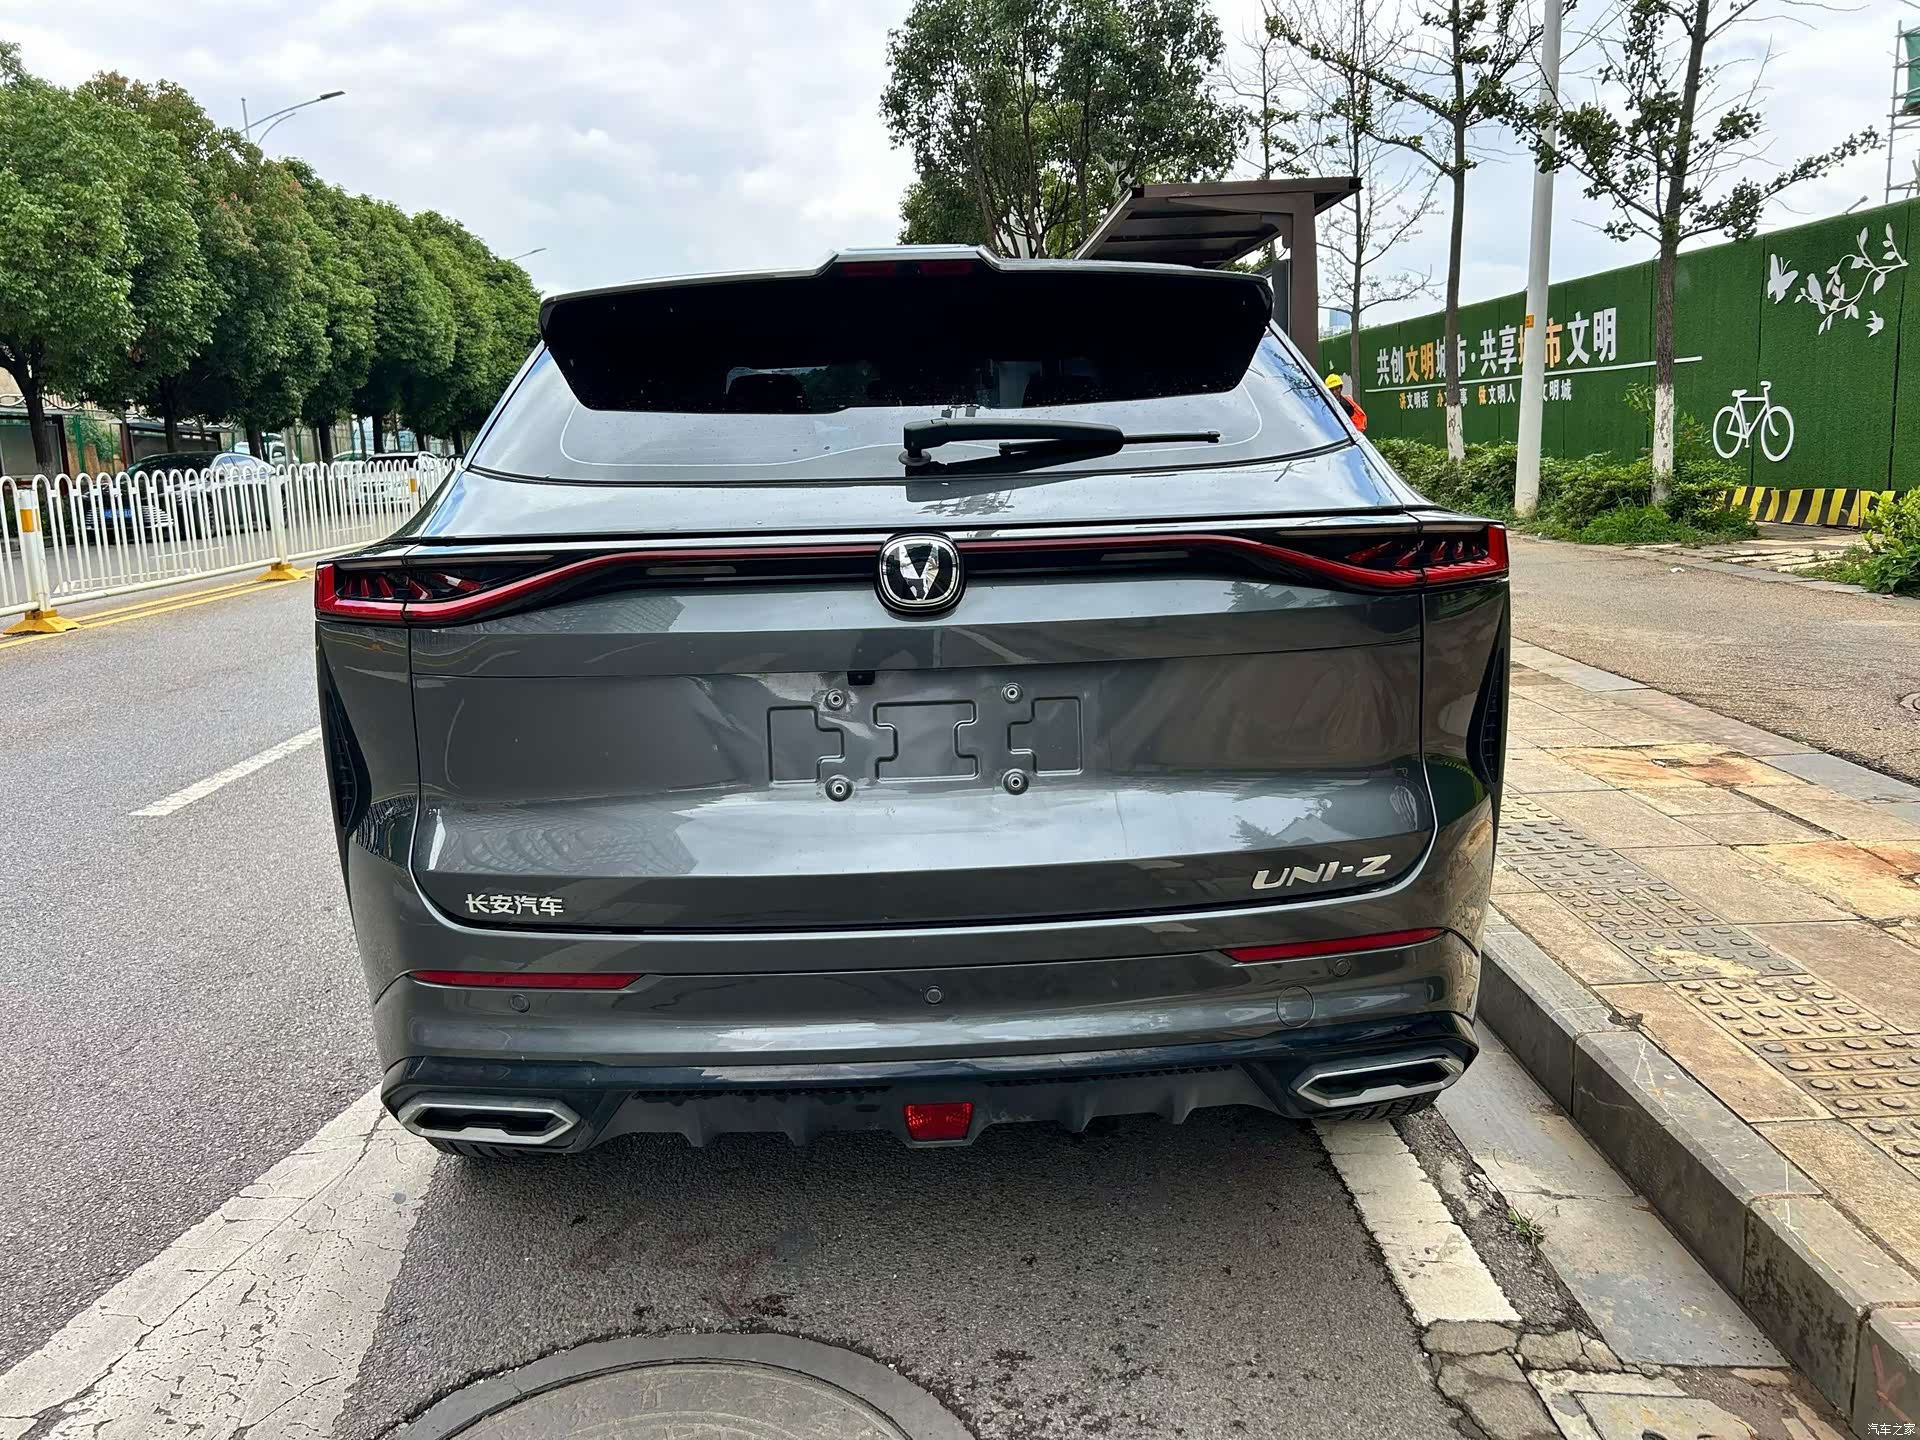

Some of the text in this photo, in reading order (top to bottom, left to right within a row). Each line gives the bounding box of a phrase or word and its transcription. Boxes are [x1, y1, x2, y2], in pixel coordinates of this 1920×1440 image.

[1252, 854, 1392, 890] UNI-Z
[465, 893, 564, 917] 长安汽车
